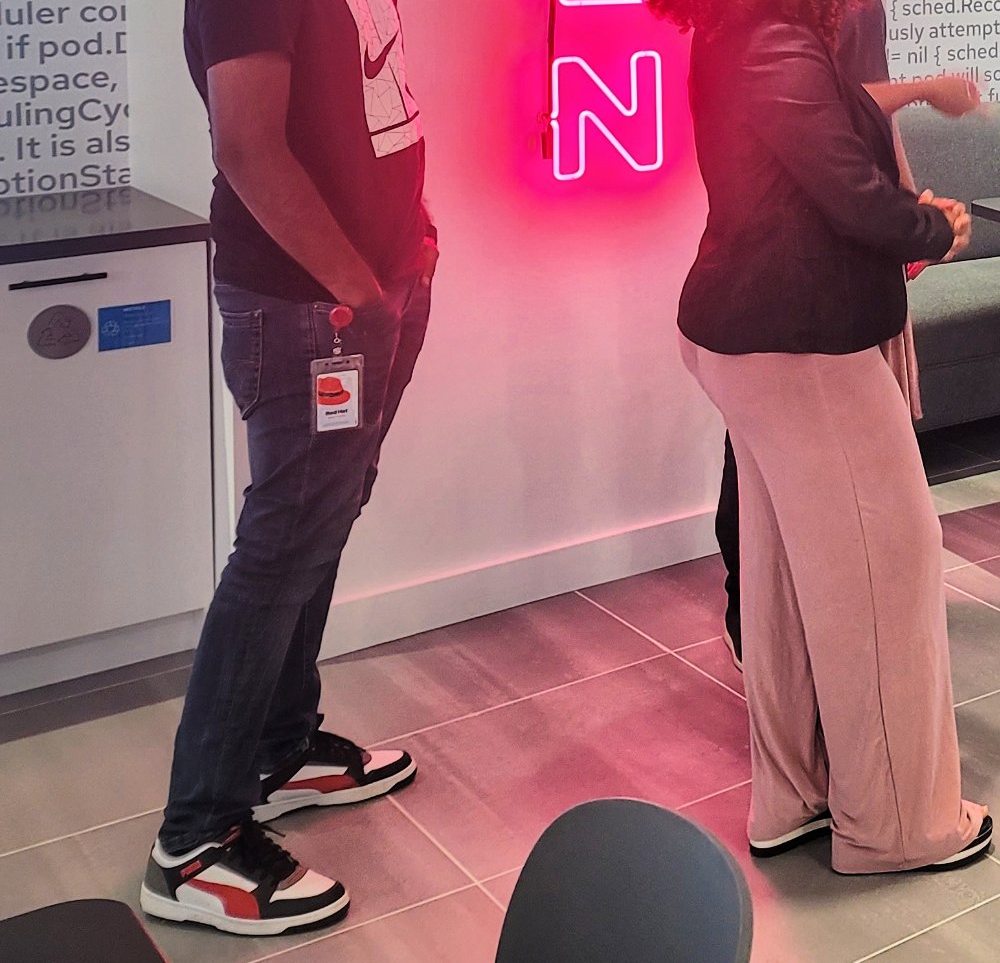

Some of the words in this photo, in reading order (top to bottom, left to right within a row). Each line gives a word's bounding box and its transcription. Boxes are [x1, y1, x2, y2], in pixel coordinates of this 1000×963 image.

[0, 0, 70, 26] uler
[80, 4, 126, 23] co
[888, 24, 925, 44] usly
[929, 18, 1000, 41] attempt
[7, 34, 30, 59] if
[908, 46, 927, 64] nil
[51, 133, 76, 157] is
